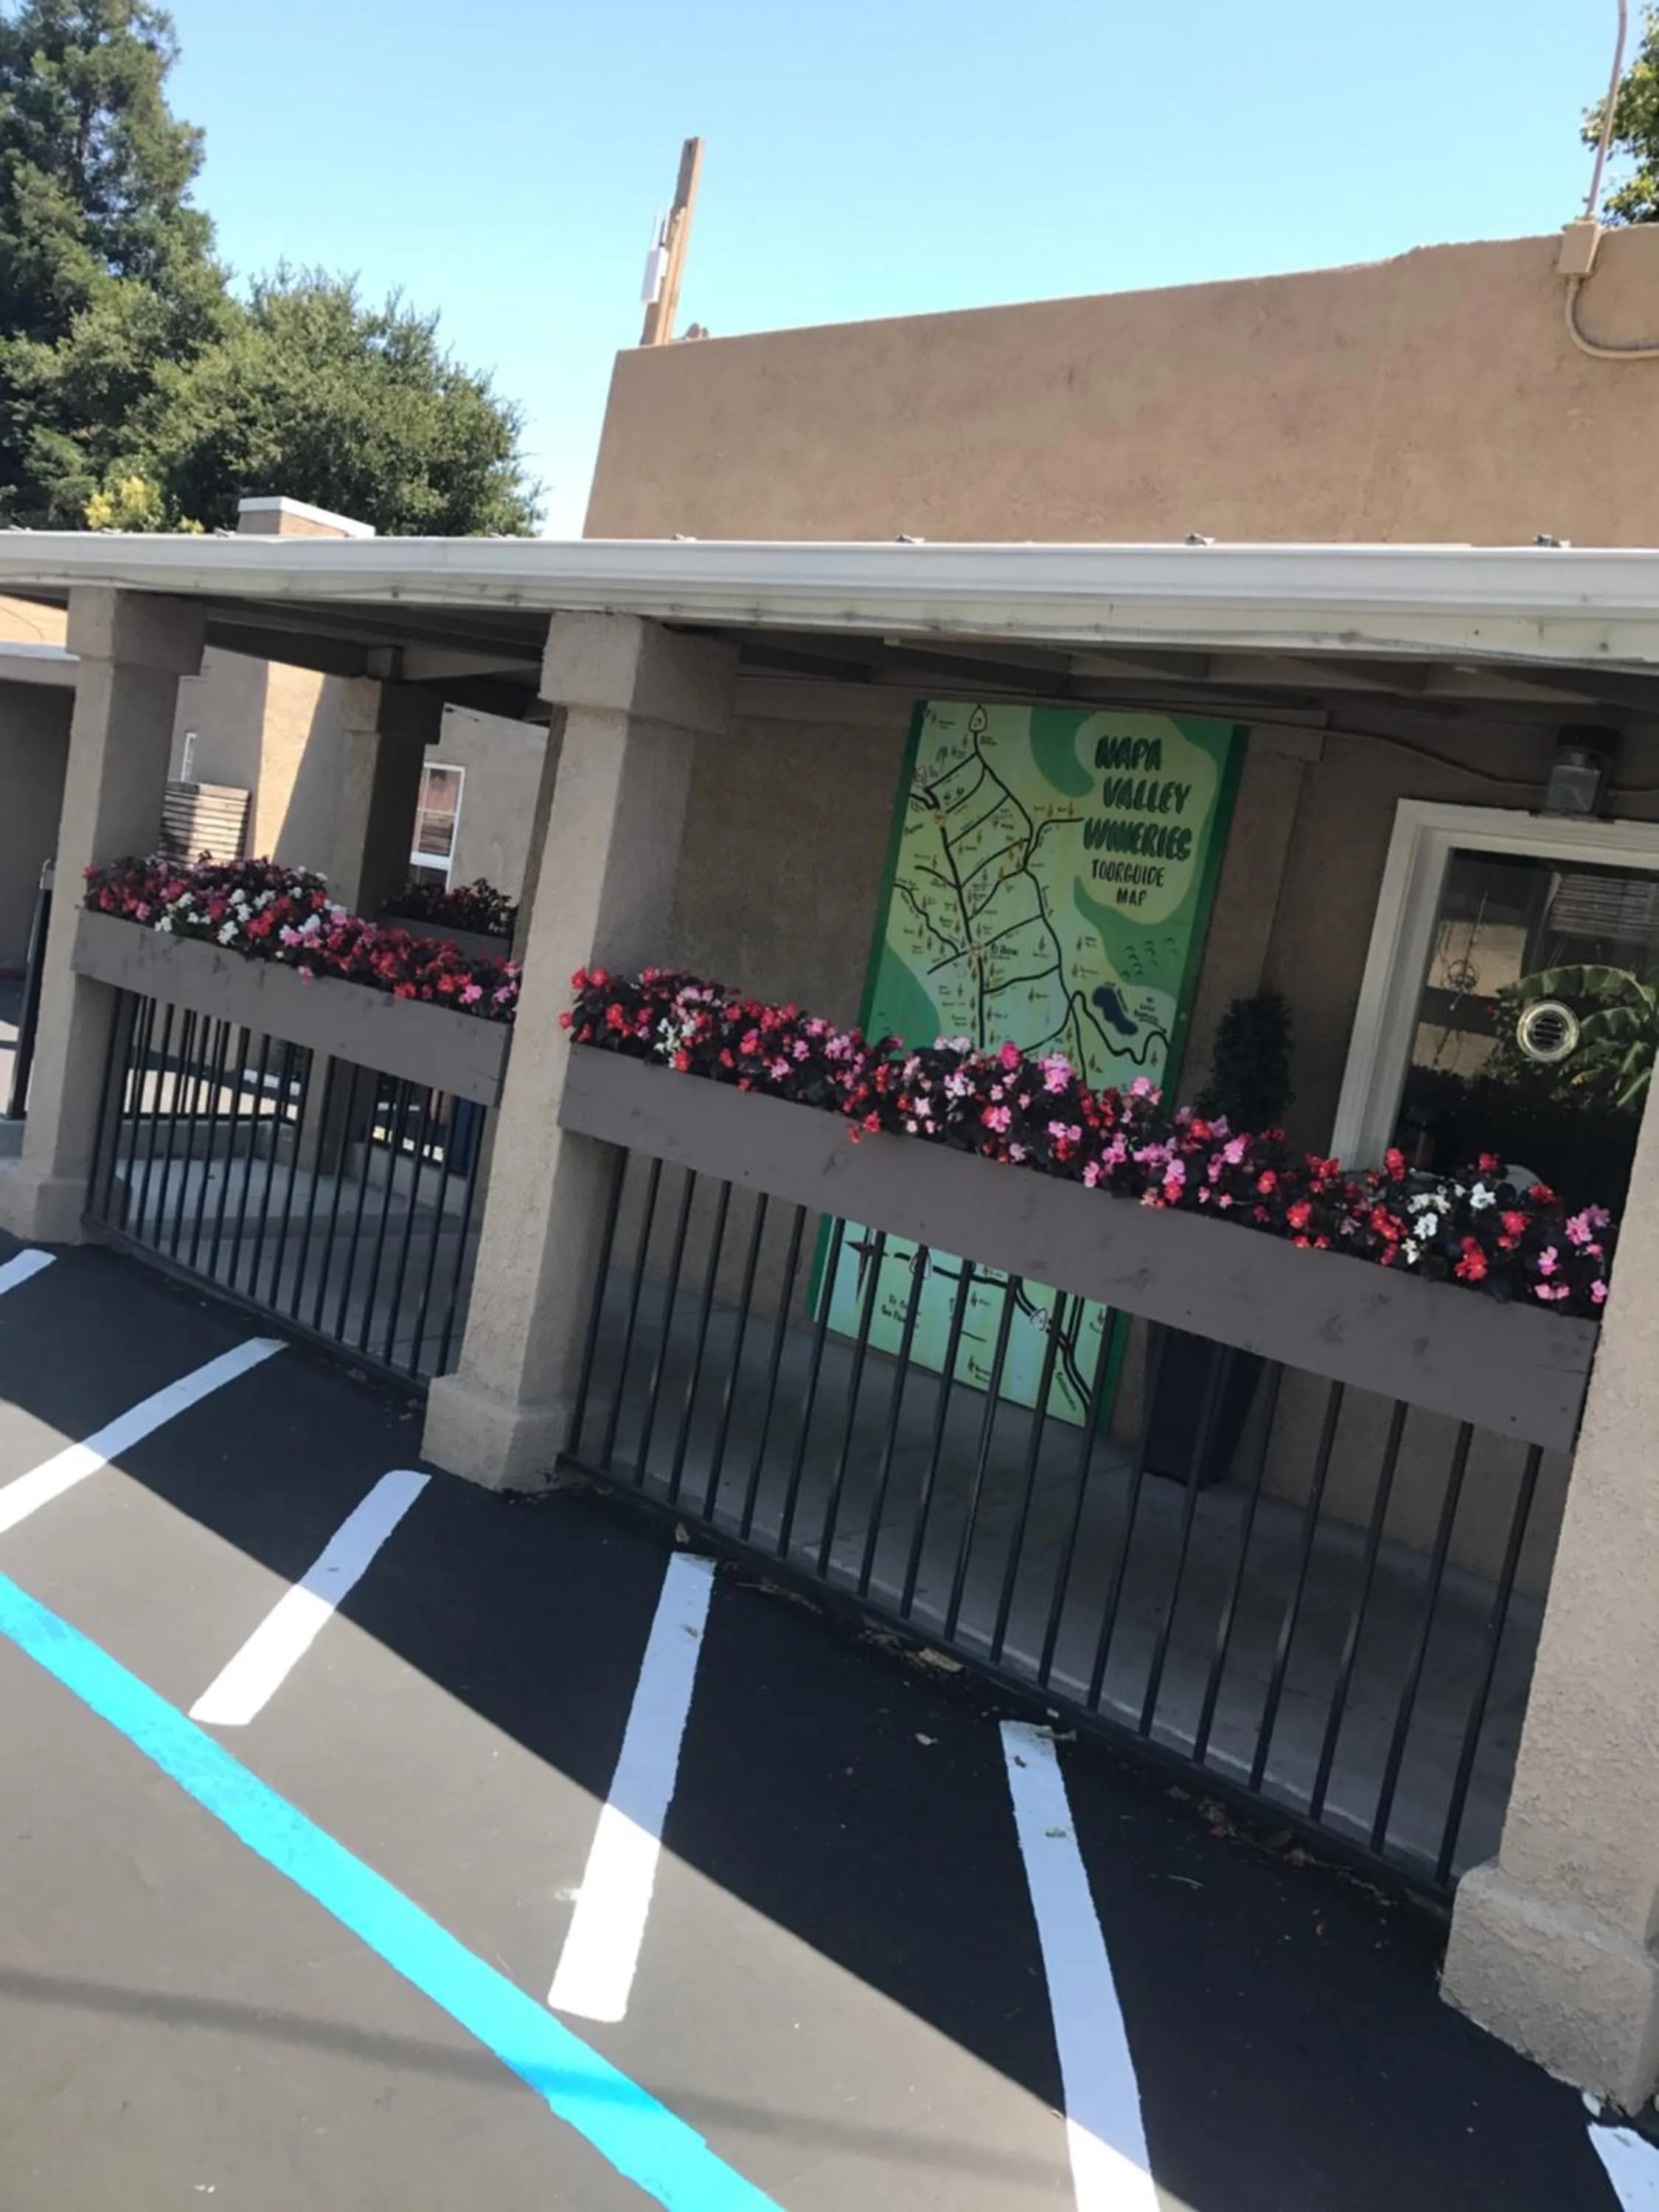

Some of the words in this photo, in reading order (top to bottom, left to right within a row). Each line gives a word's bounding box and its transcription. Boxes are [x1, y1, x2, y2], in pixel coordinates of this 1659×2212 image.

[1095, 736, 1163, 772] NAPA
[1103, 776, 1192, 814] VALLEY
[1083, 817, 1192, 861] WINERIES
[1092, 859, 1165, 887] TOURGUIDE
[1116, 888, 1147, 906] MAP
